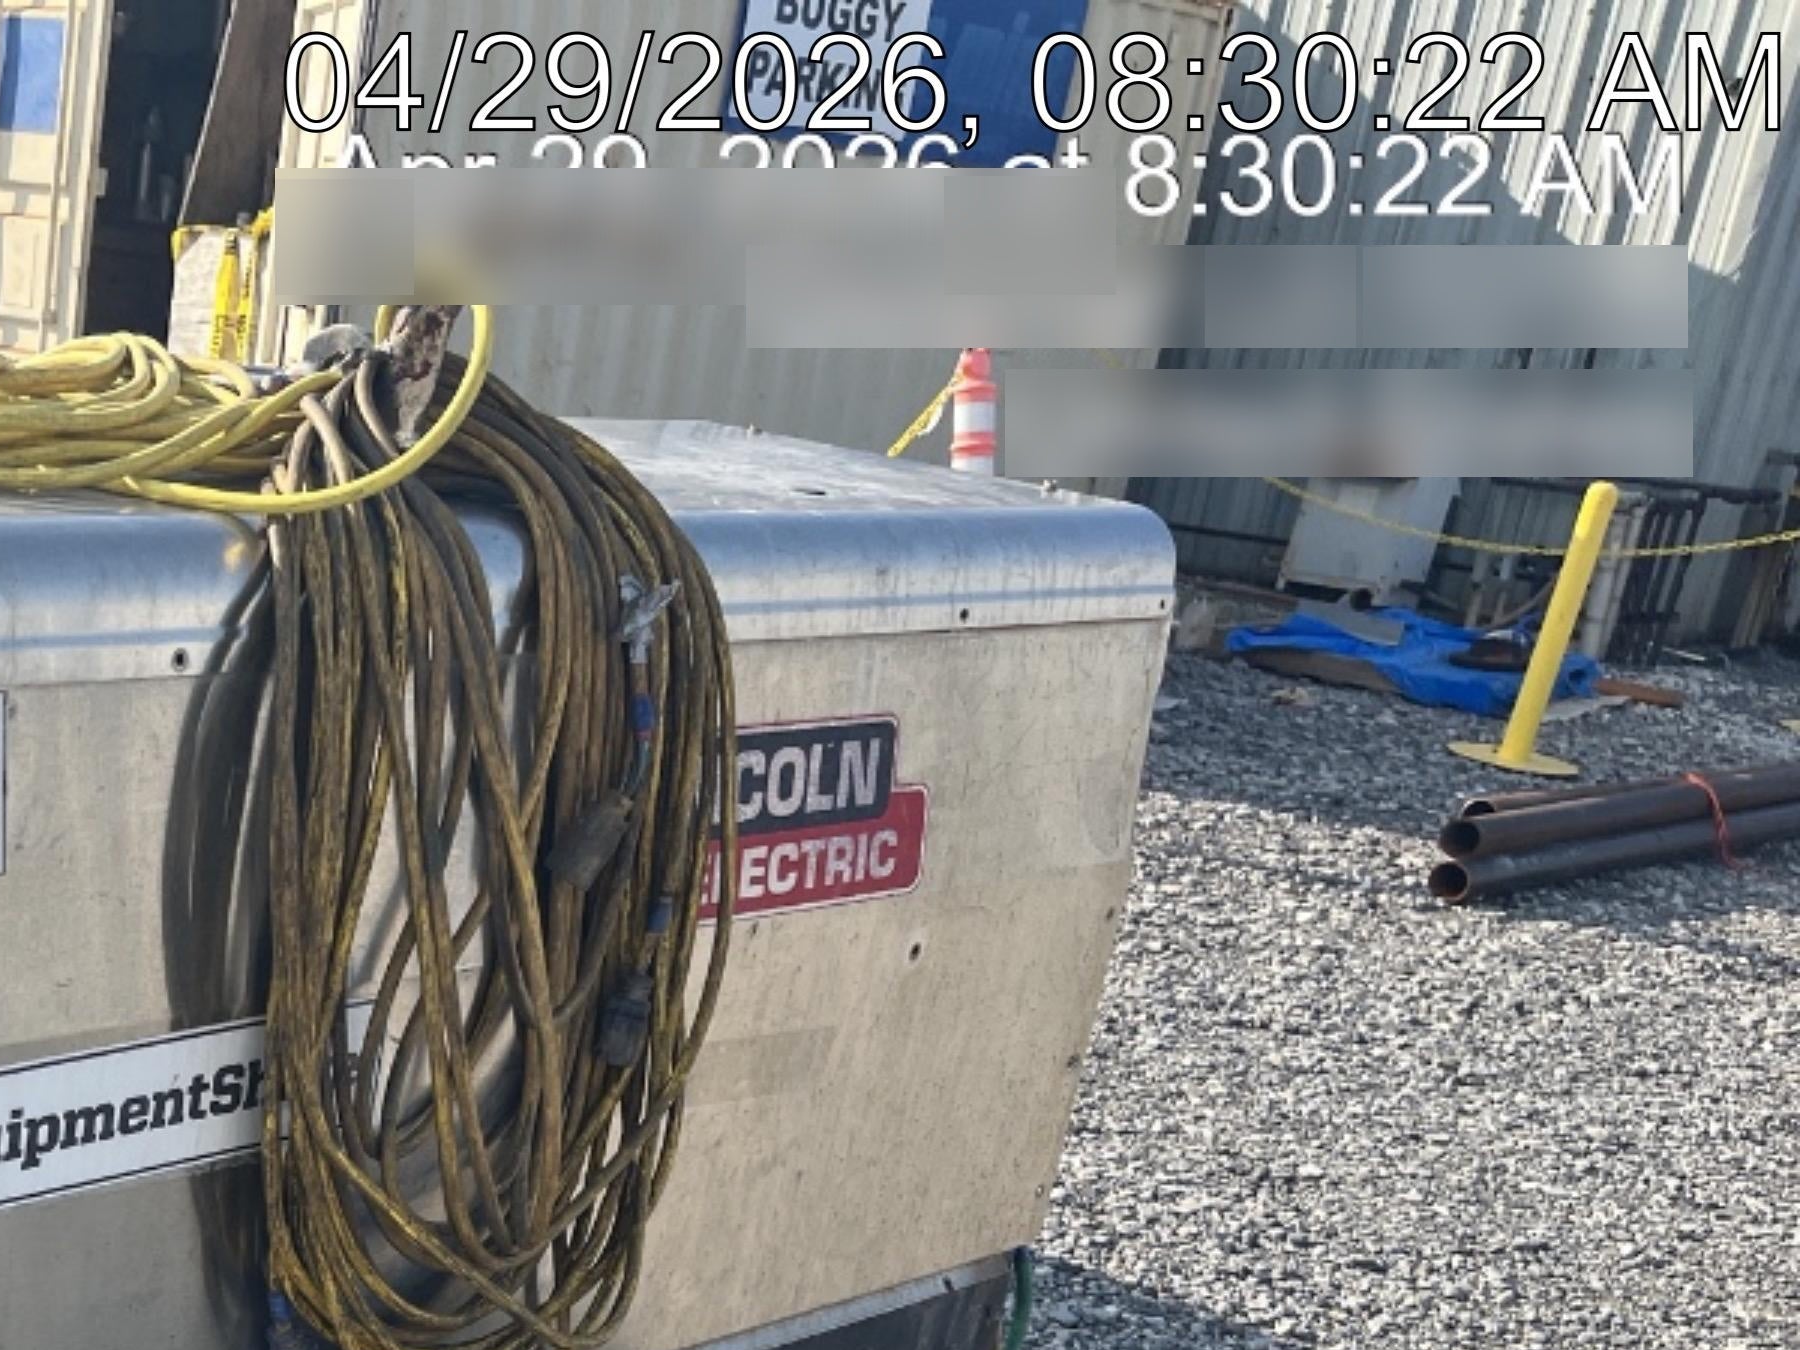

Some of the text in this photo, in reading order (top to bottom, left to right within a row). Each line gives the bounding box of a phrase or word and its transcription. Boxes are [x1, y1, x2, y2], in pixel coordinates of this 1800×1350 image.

[774, 0, 908, 43] BUGGY
[747, 50, 906, 112] PARKN
[711, 737, 881, 826] COLN
